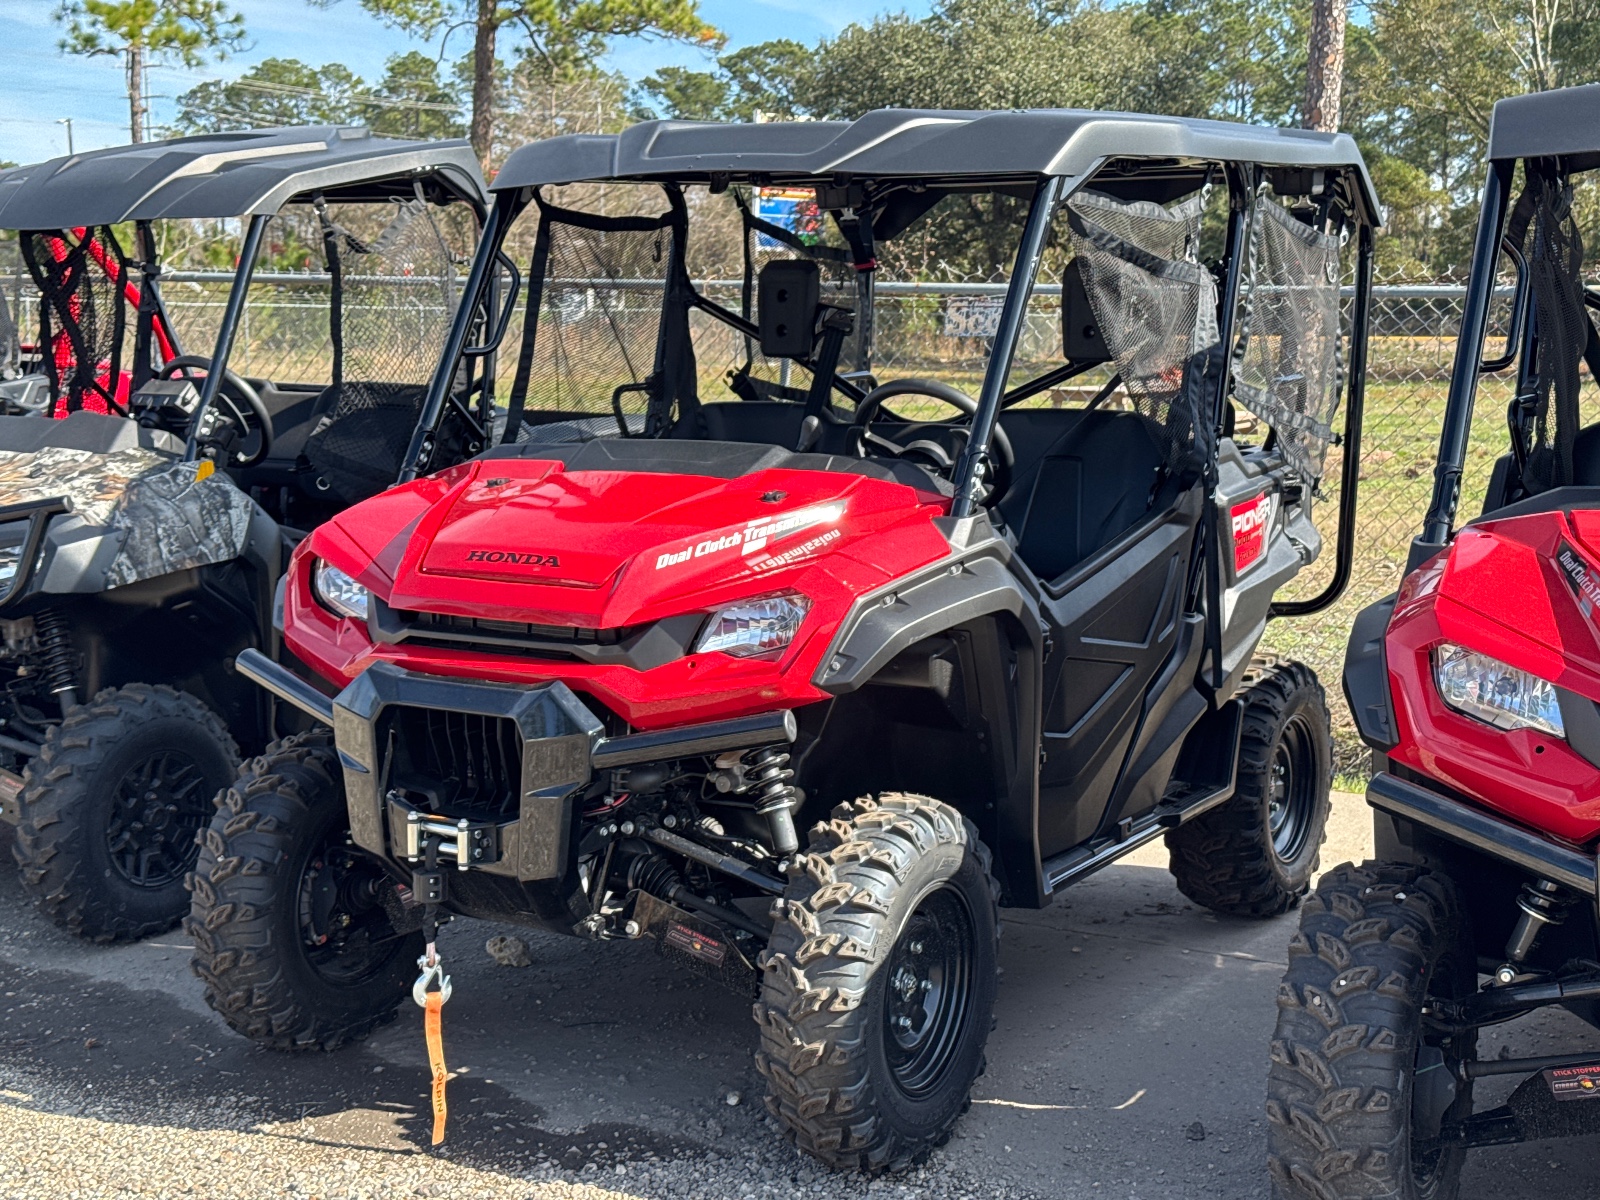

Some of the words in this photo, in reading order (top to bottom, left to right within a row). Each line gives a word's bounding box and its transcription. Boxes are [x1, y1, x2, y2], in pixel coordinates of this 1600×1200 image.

[465, 551, 560, 567] HONDA
[656, 547, 692, 569] Dual
[1559, 551, 1579, 571] Dual
[1572, 567, 1596, 593] Clutch
